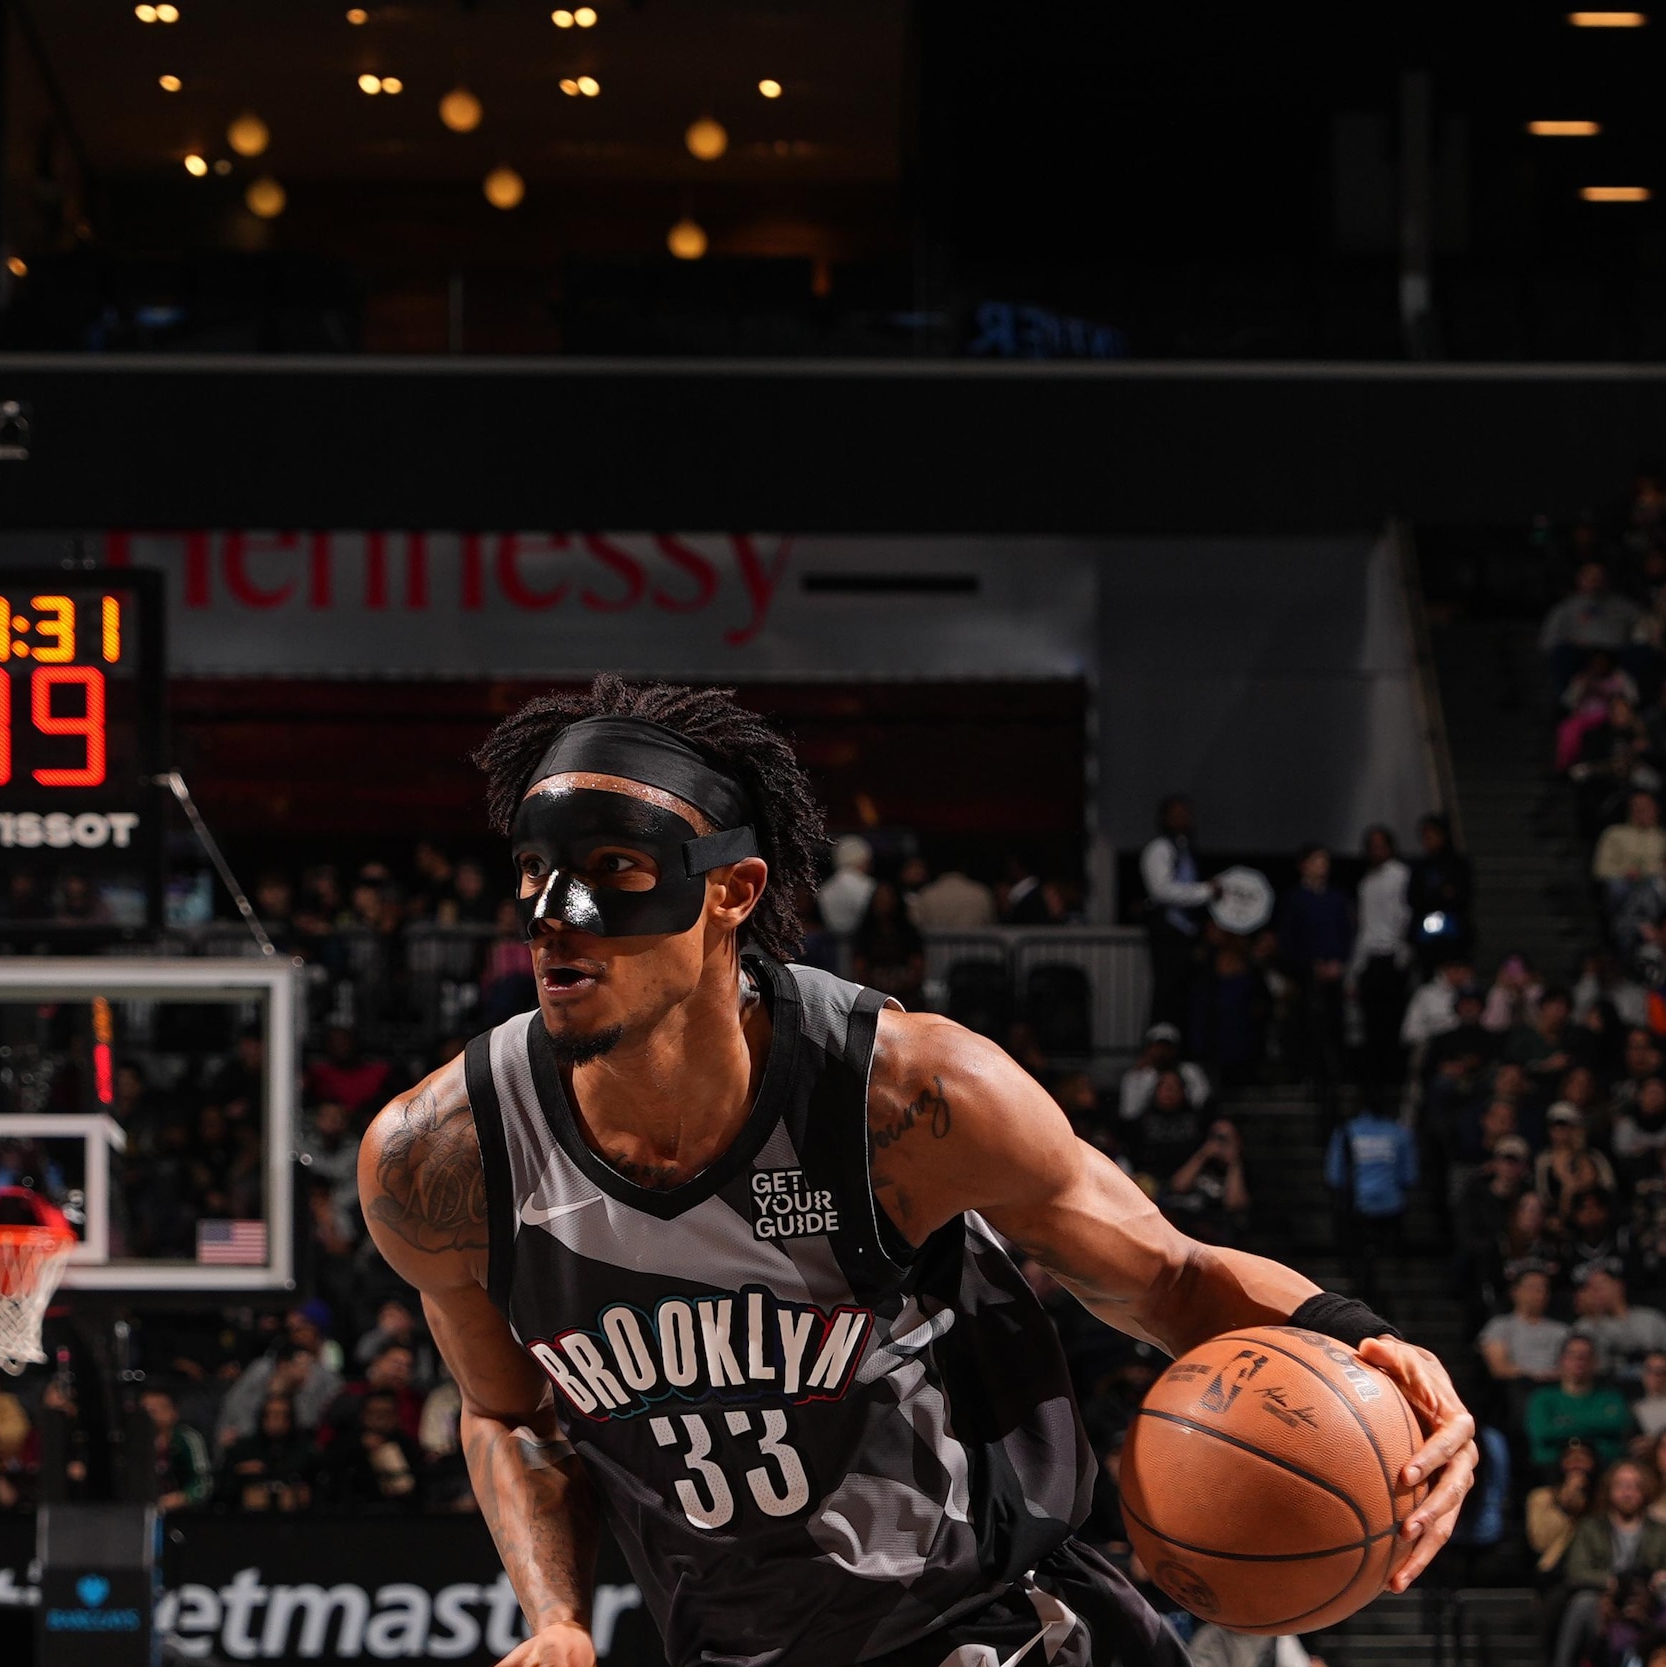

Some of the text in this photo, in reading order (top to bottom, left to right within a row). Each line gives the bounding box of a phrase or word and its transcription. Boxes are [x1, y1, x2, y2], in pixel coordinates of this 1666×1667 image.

[751, 1170, 803, 1194] GET
[753, 1190, 833, 1216] YOUR
[755, 1211, 840, 1238] GUIDE
[530, 1291, 869, 1416] BROOKLYN
[648, 1408, 811, 1530] 33
